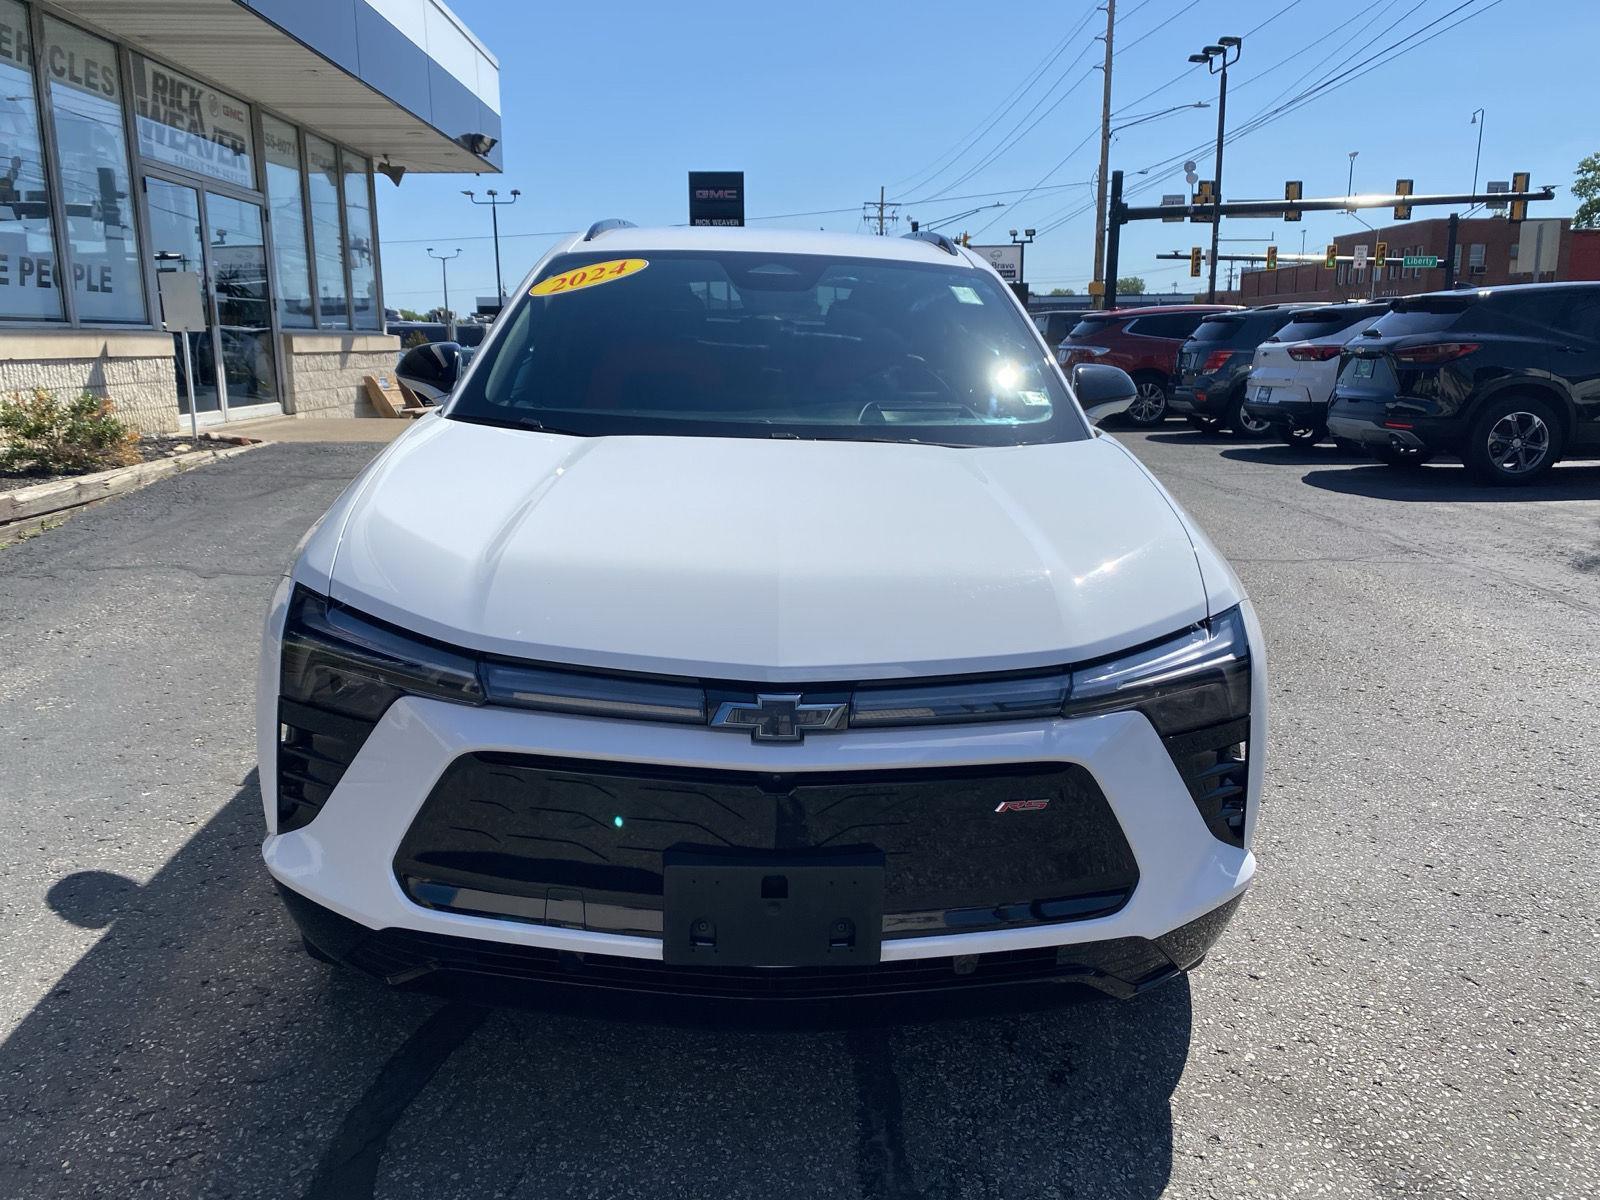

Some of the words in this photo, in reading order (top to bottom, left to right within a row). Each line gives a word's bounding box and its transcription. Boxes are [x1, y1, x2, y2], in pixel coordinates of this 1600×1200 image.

[0, 23, 115, 97] EHCLES
[152, 70, 205, 114] RICK
[222, 105, 244, 122] GMC
[138, 98, 249, 171] WEAVER
[696, 190, 737, 199] GMC
[1407, 257, 1434, 266] Liberty
[550, 261, 628, 292] 2024
[994, 800, 1049, 813] RS
